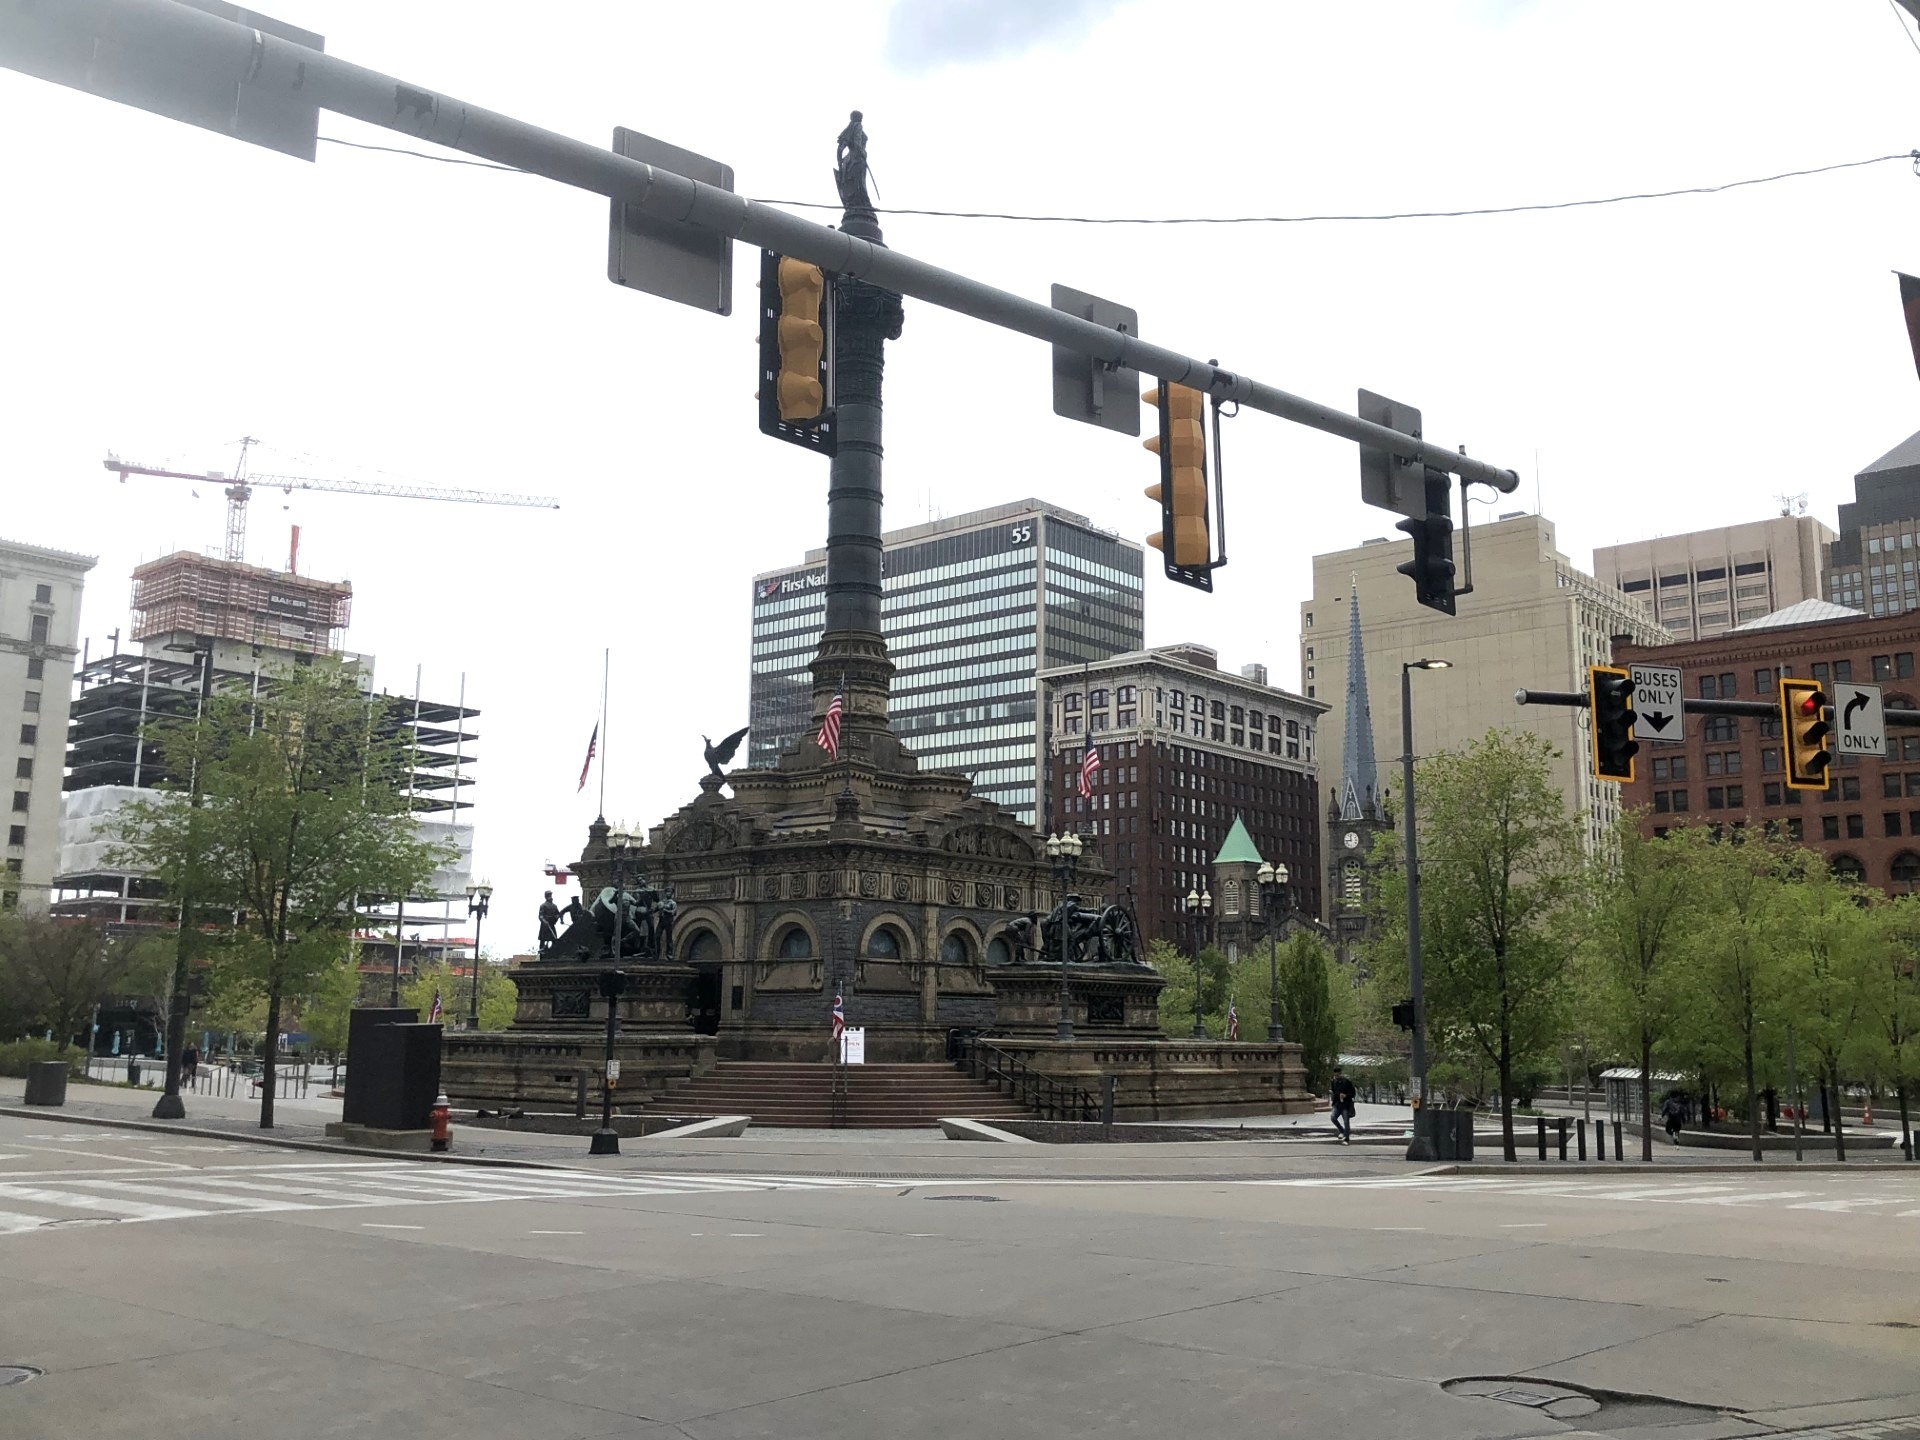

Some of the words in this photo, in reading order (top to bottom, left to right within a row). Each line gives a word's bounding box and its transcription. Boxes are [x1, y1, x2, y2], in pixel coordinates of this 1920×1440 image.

[1012, 526, 1031, 544] 55
[781, 577, 805, 593] First
[1634, 671, 1678, 688] BUSES
[1638, 688, 1675, 705] ONLY
[1844, 734, 1880, 750] ONLY
